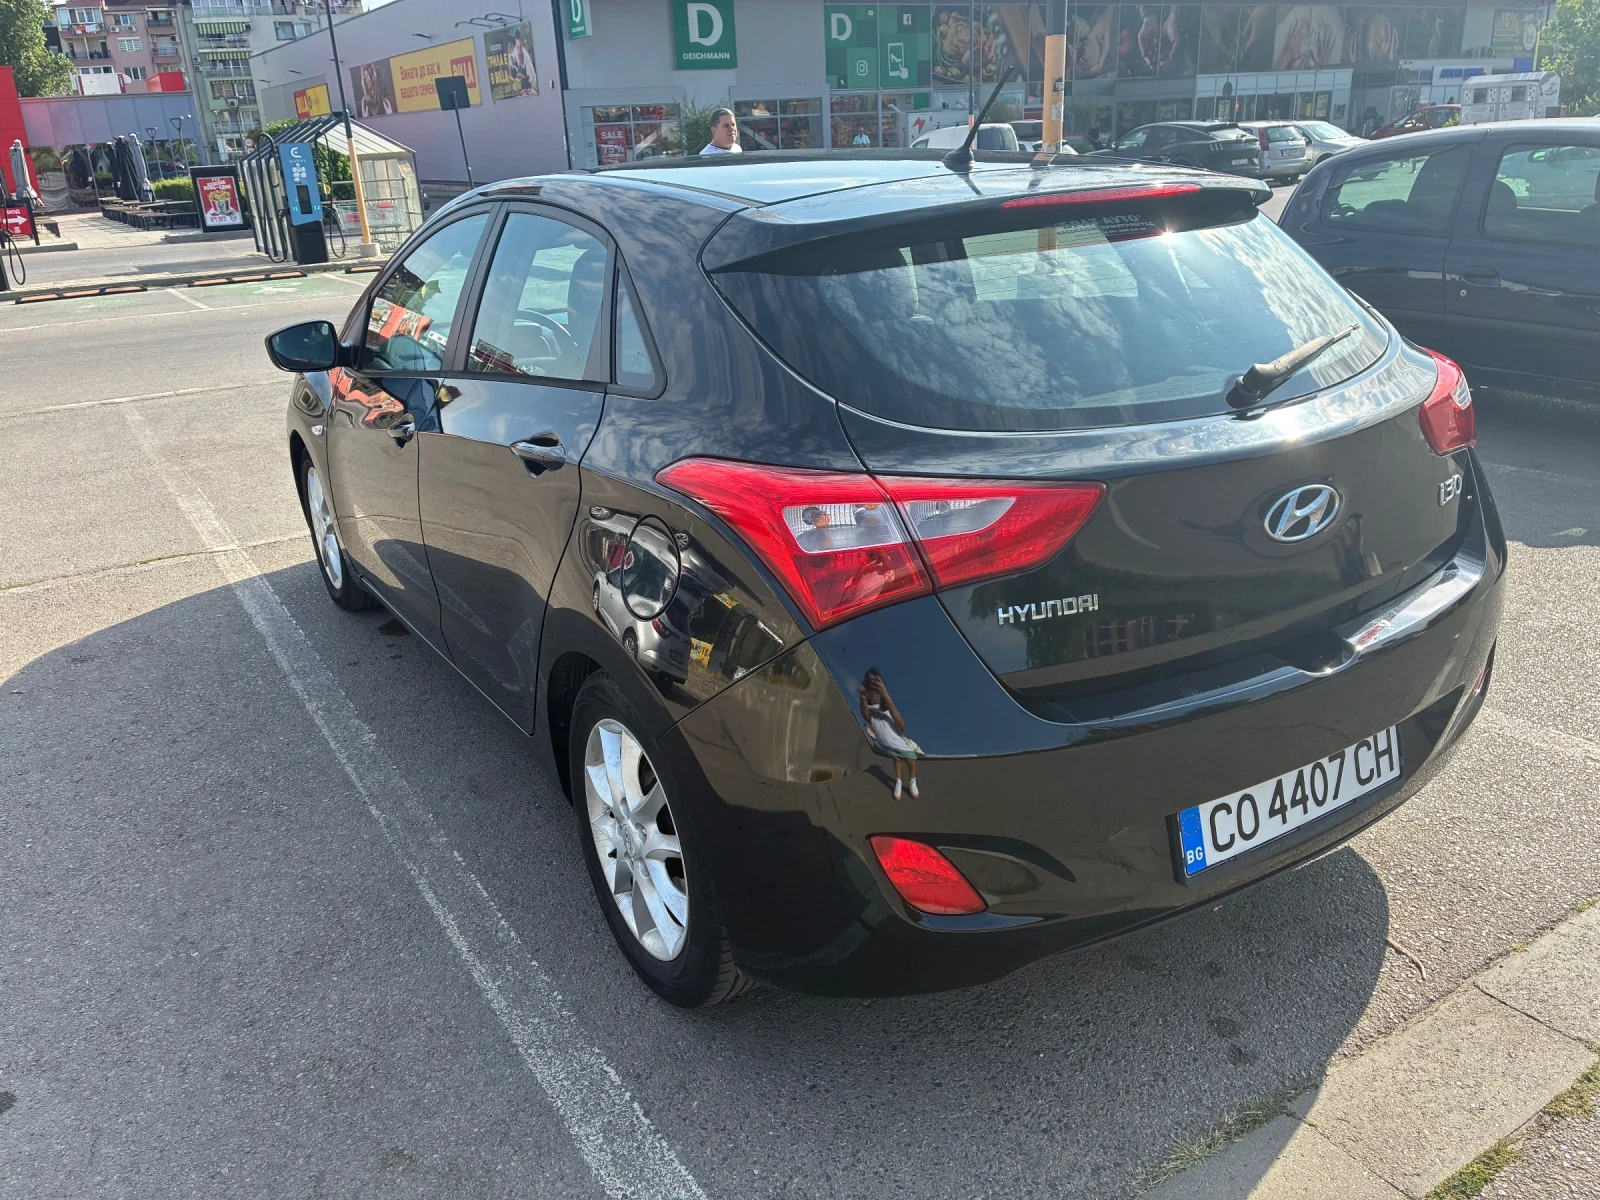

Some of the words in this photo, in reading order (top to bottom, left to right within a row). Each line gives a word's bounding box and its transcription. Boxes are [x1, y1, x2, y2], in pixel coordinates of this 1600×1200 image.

[687, 2, 723, 46] D
[830, 12, 852, 41] D
[600, 131, 624, 140] SALE
[602, 144, 625, 154] 75%
[1440, 474, 1462, 506] i30
[998, 594, 1098, 625] HYUNDAI
[1210, 794, 1260, 852] CO
[1268, 749, 1345, 826] 4407
[1354, 725, 1394, 786] CH
[1186, 846, 1203, 864] BG
